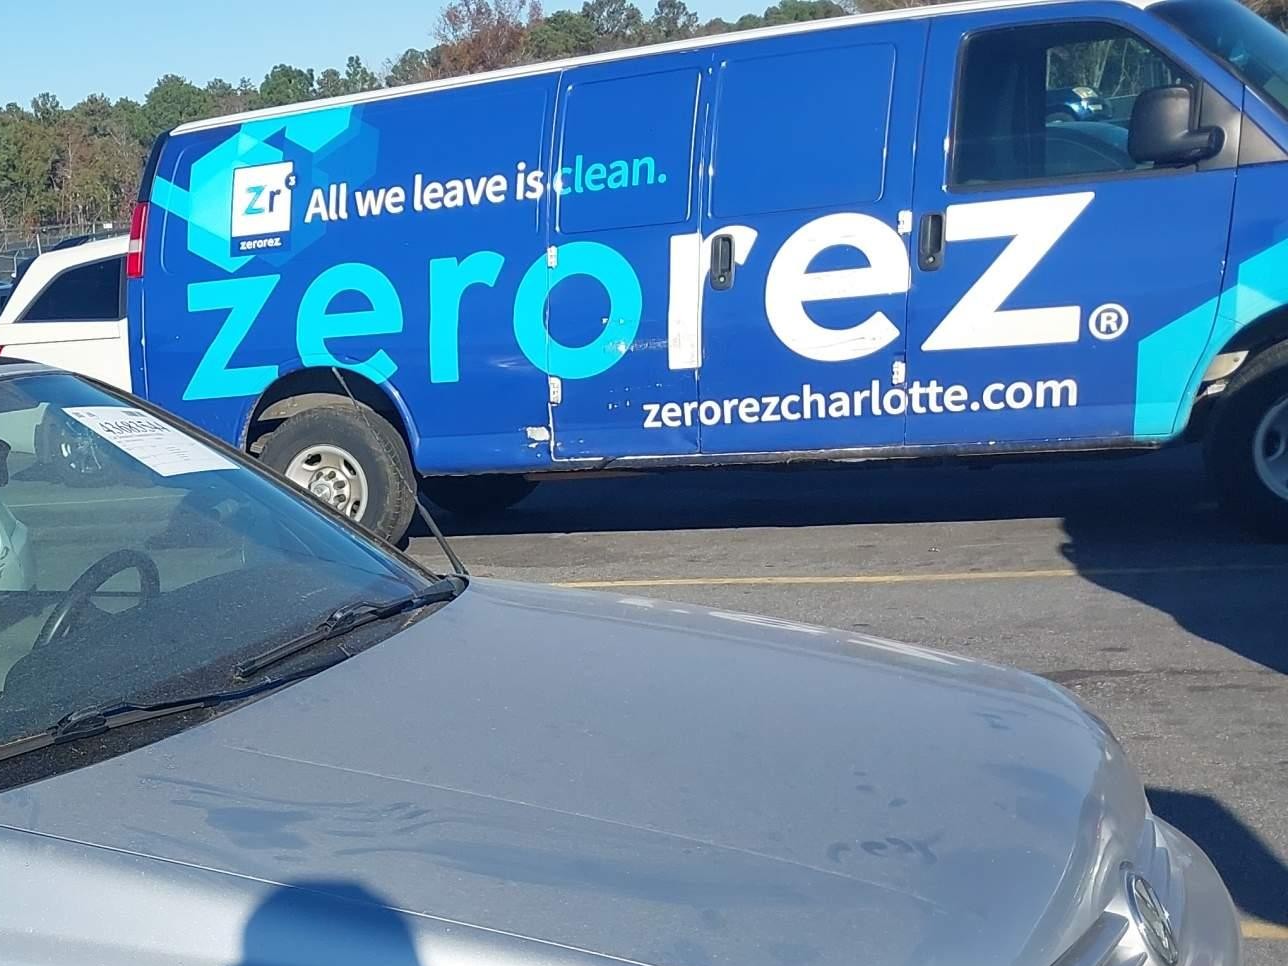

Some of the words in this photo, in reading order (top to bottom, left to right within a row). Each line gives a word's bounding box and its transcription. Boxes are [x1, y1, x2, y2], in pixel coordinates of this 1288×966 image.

[304, 183, 348, 223] All
[354, 188, 406, 217] we
[413, 172, 510, 212] leave
[516, 161, 545, 200] is
[554, 154, 667, 197] clean.
[239, 236, 283, 251] zerorez
[643, 378, 1079, 428] zerorezcharlotte.com
